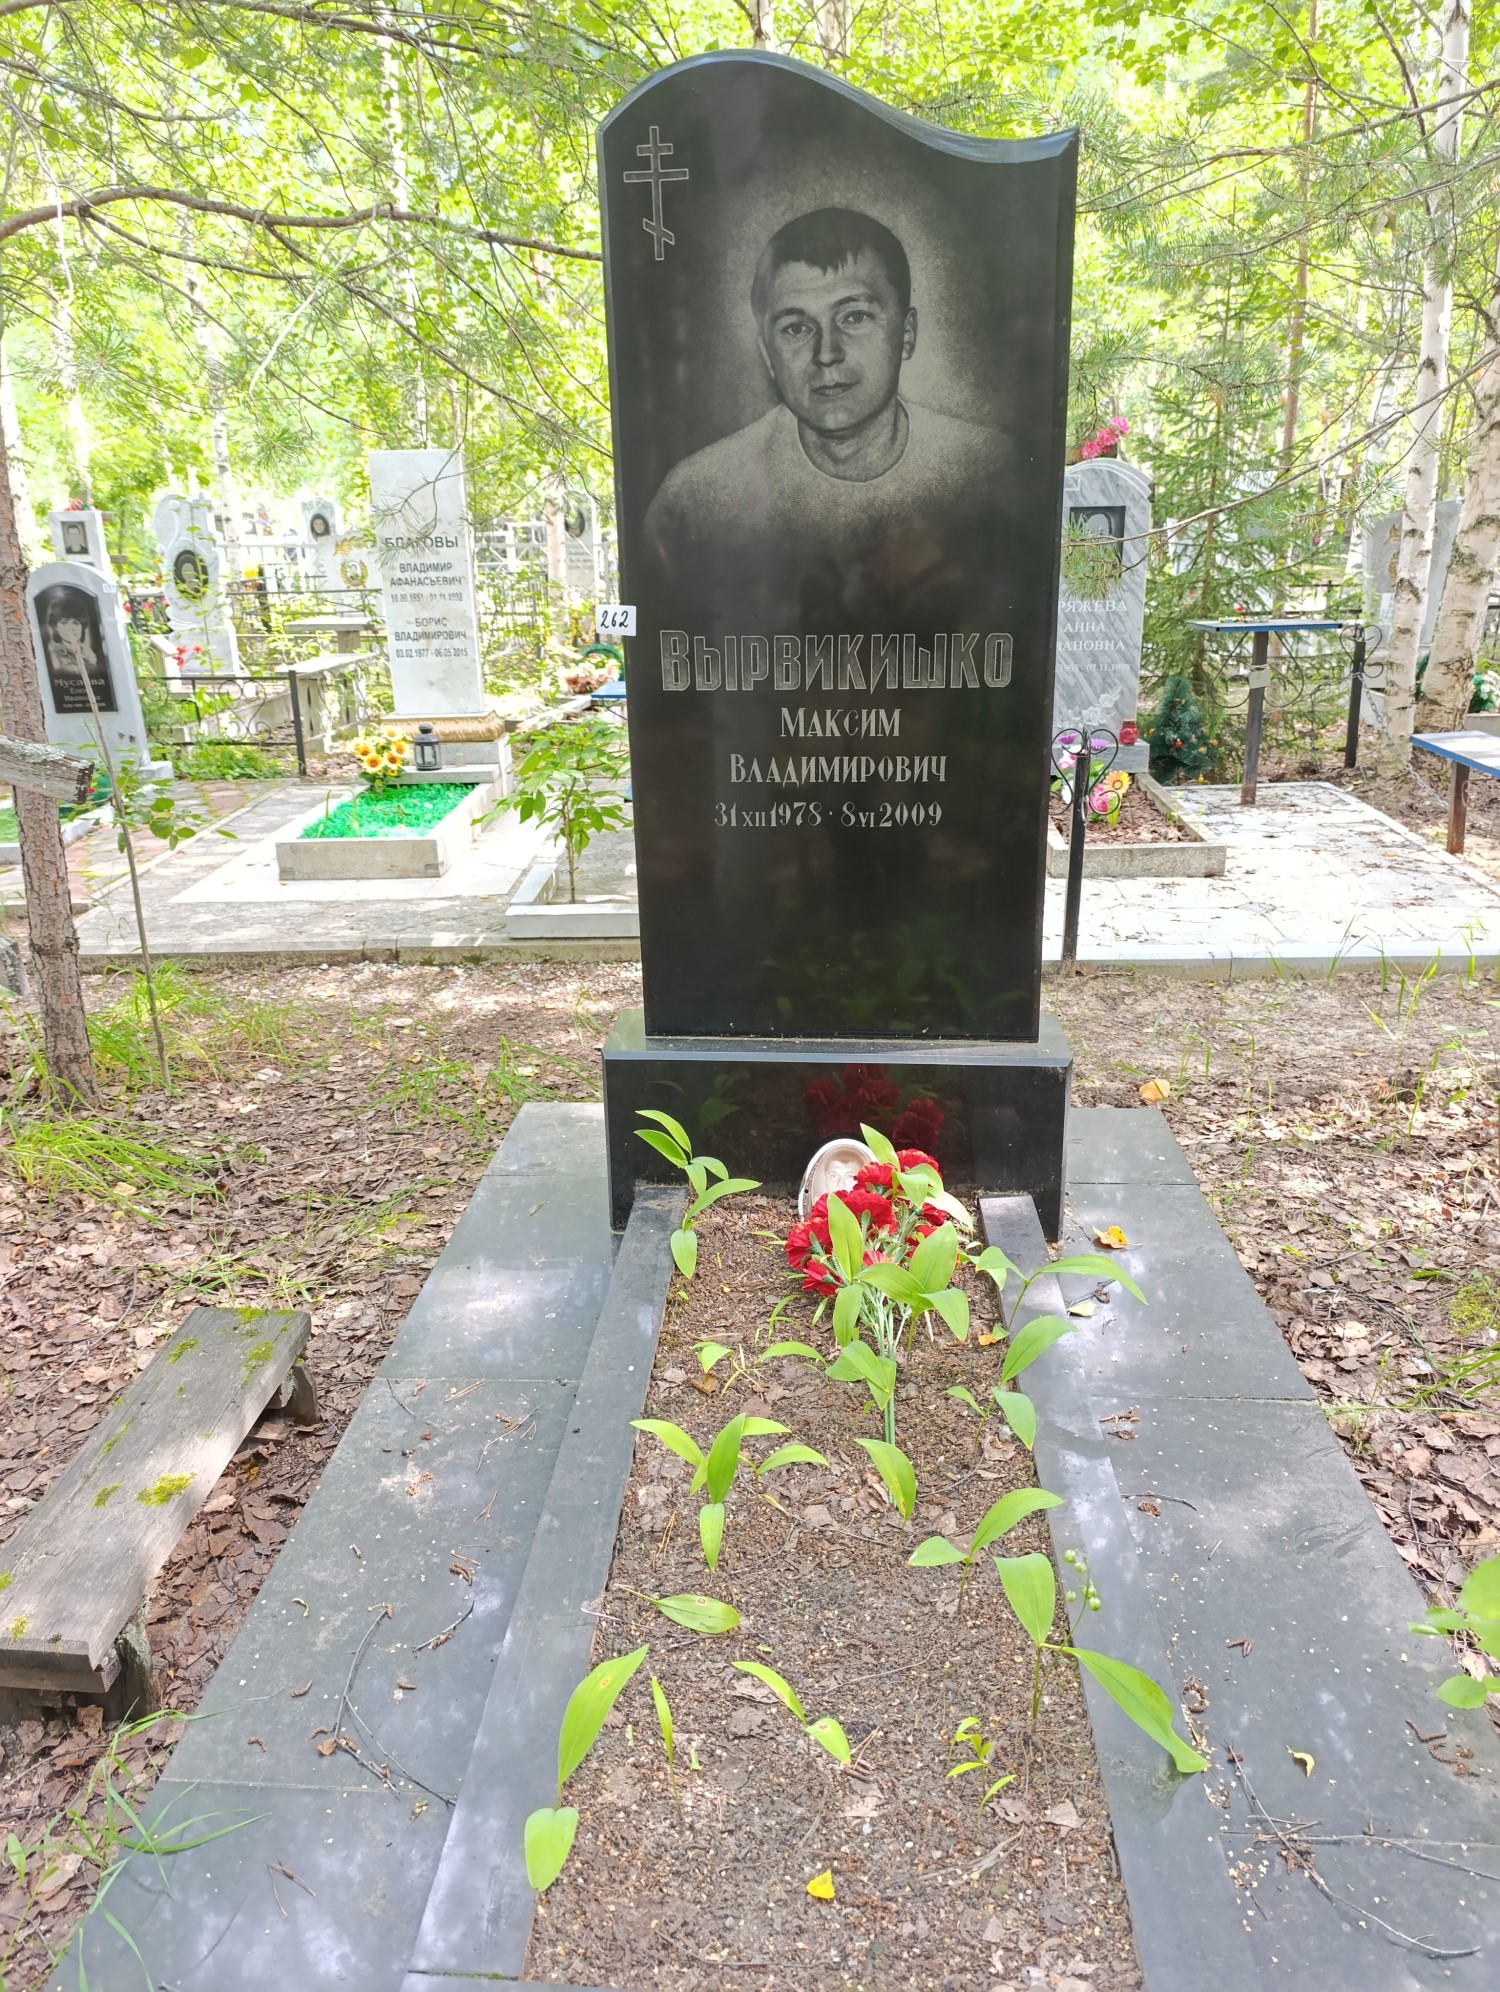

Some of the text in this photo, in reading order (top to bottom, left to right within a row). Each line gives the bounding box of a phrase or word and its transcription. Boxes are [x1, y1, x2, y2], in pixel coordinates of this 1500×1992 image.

[399, 562, 453, 574] ВЛАДИМИР
[390, 575, 463, 588] АФАНАСЬЕВИЧ
[1058, 600, 1127, 613] РЯЖЕВА
[415, 617, 448, 628] БОРИС
[600, 610, 629, 629] 262
[1063, 621, 1106, 633] АННА
[394, 630, 467, 642] ВЛАДИМИРОВИЧ
[1057, 640, 1126, 651] ВАНОВНА
[659, 630, 1013, 694] ВЫРВИКИШКО
[54, 678, 106, 688] Мусава
